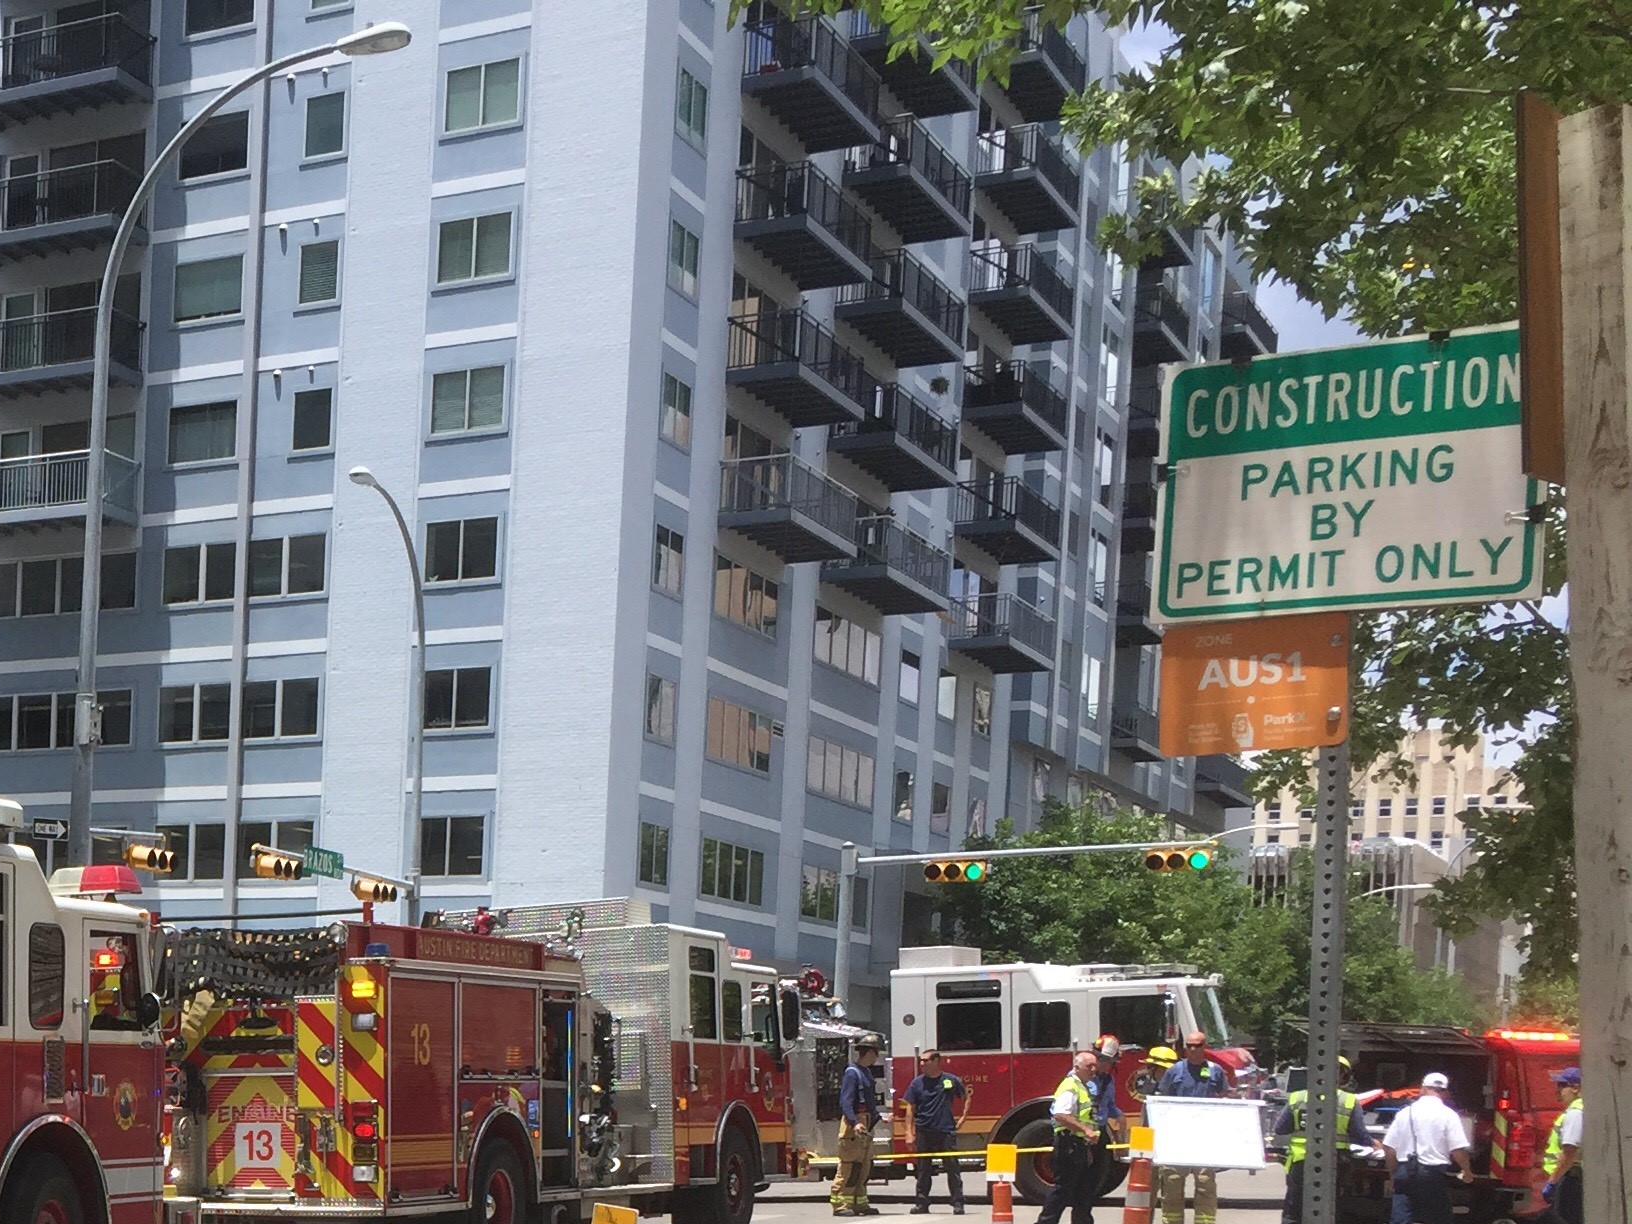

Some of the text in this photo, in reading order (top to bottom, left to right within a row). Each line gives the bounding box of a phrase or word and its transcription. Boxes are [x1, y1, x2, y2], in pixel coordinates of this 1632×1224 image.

[1186, 352, 1521, 439] CONSTRUCTION
[1240, 443, 1455, 501] PARKING
[1309, 498, 1376, 541] BY
[1176, 535, 1514, 599] PERMIT ONLY
[1195, 633, 1233, 648] ZONE
[1198, 650, 1307, 691] AUS1
[419, 934, 453, 958] AUSTIN
[410, 1023, 431, 1066] 13
[217, 1104, 296, 1124] ENGINE
[242, 1129, 274, 1161] 13
